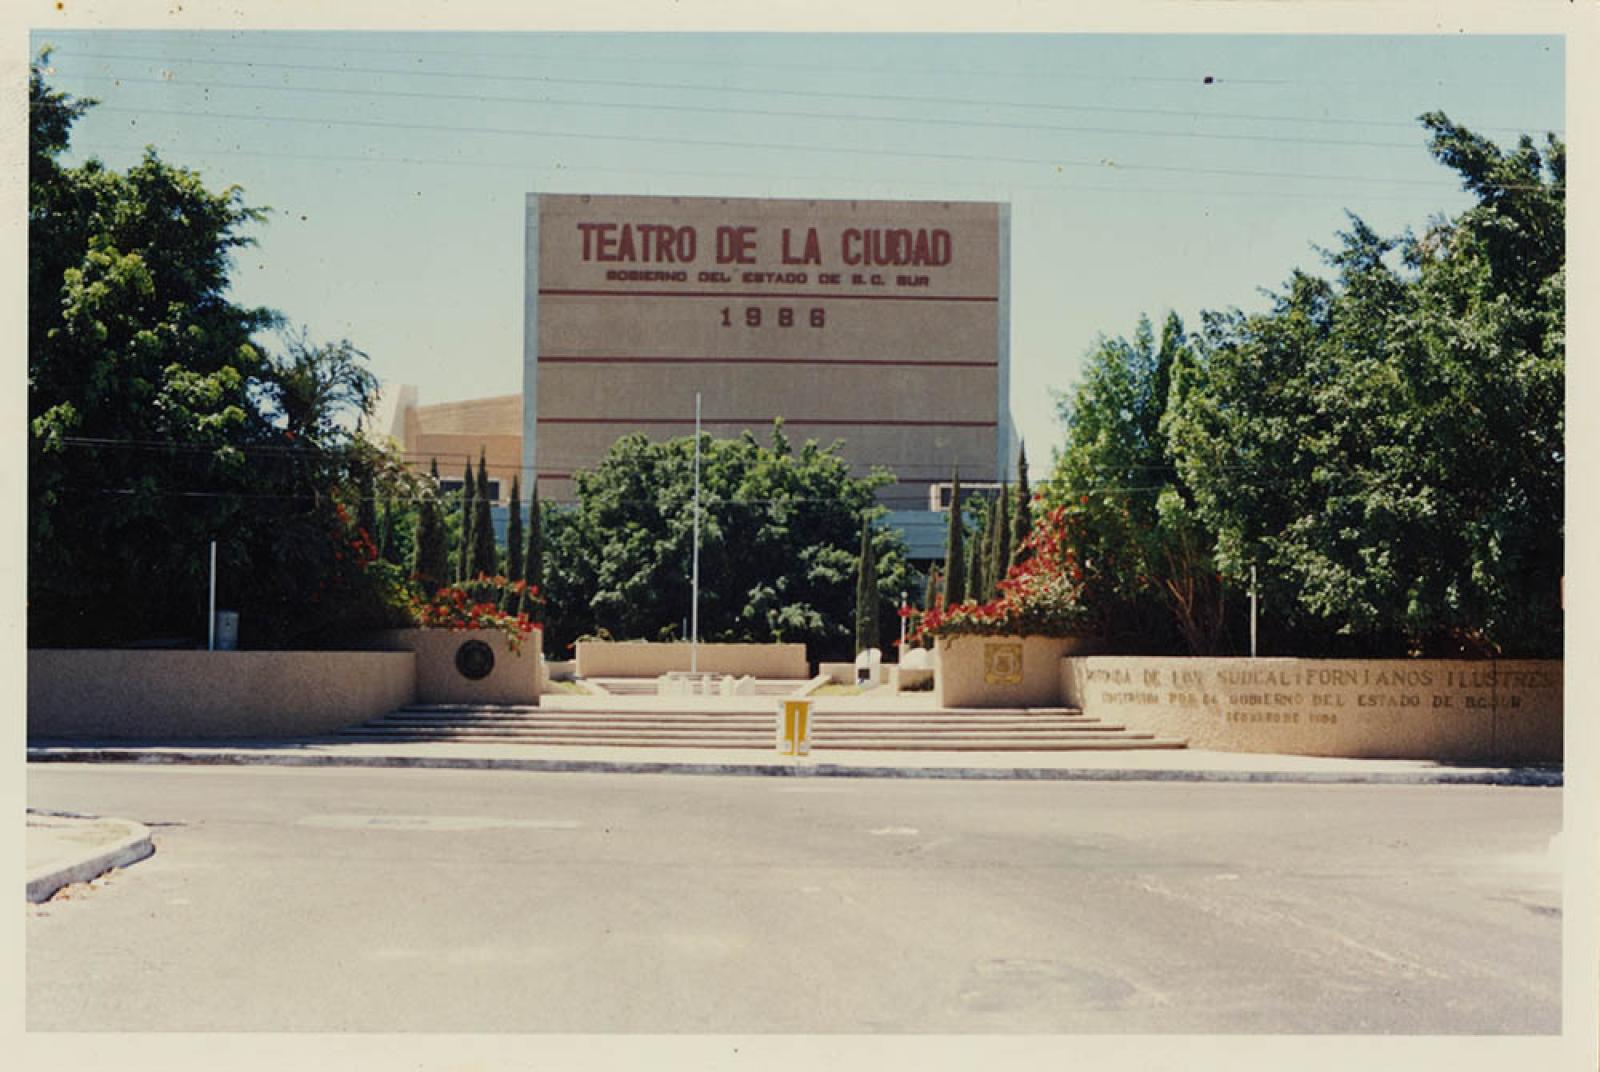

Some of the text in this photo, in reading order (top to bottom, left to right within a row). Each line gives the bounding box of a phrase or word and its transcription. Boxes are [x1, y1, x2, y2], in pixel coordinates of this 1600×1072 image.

[577, 223, 952, 267] TEATRO DE LA CIUDAD
[605, 269, 688, 283] GOBIERNO
[698, 271, 731, 284] DEL
[742, 271, 808, 286] ESTADO
[818, 273, 841, 286] DE
[896, 275, 930, 288] SUR
[720, 306, 826, 329] 1986
[1311, 693, 1345, 708] DEL
[1357, 694, 1421, 708] ESTADO
